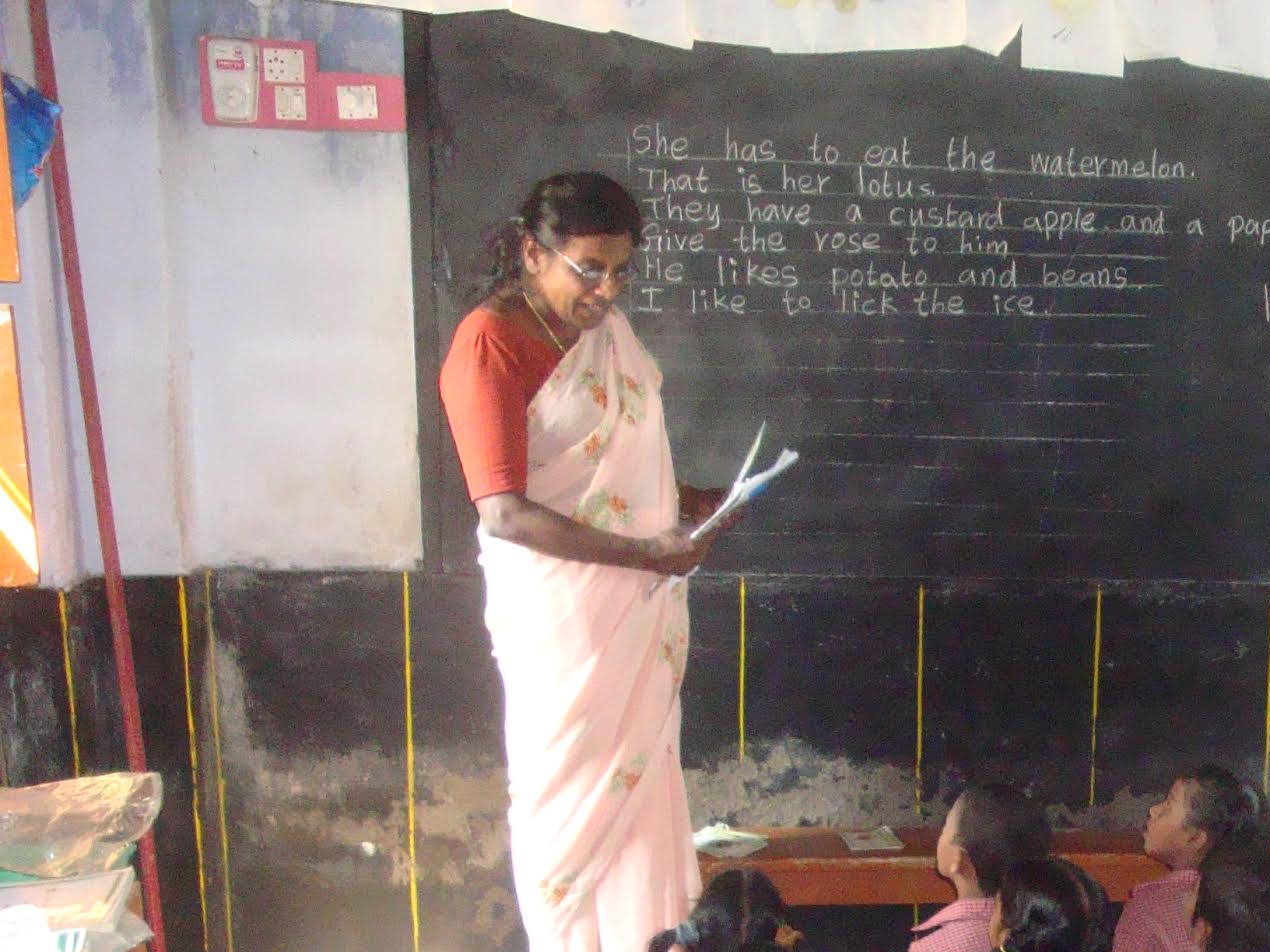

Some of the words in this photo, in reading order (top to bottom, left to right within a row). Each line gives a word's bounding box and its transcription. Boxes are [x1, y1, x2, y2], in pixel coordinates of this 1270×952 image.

[632, 122, 689, 161] She
[725, 127, 777, 163] has
[808, 132, 840, 165] to
[864, 137, 912, 169] eat
[946, 135, 996, 172] the
[1030, 148, 1197, 179] watermelon.
[638, 166, 710, 194] That
[738, 167, 763, 195] is
[782, 164, 832, 195] her
[858, 165, 936, 198] lotus.
[640, 195, 721, 230] They
[748, 198, 812, 226] have
[845, 203, 863, 223] a
[889, 200, 1004, 232] custard
[1023, 207, 1096, 241] apple
[1120, 209, 1164, 235] and
[1186, 217, 1204, 237] a
[640, 223, 705, 253] Give
[733, 225, 788, 253] the
[814, 230, 881, 252] rose
[906, 230, 938, 256] to
[960, 231, 1009, 260] him
[645, 256, 684, 282] He
[718, 255, 800, 287] likes
[831, 260, 928, 296] potato
[957, 259, 1019, 289] and
[1042, 263, 1143, 290] beans.
[637, 286, 665, 313] I
[691, 288, 747, 314] like
[782, 290, 812, 316] to
[841, 289, 899, 314] lick
[912, 288, 966, 316] the
[993, 294, 1049, 316] ice.
